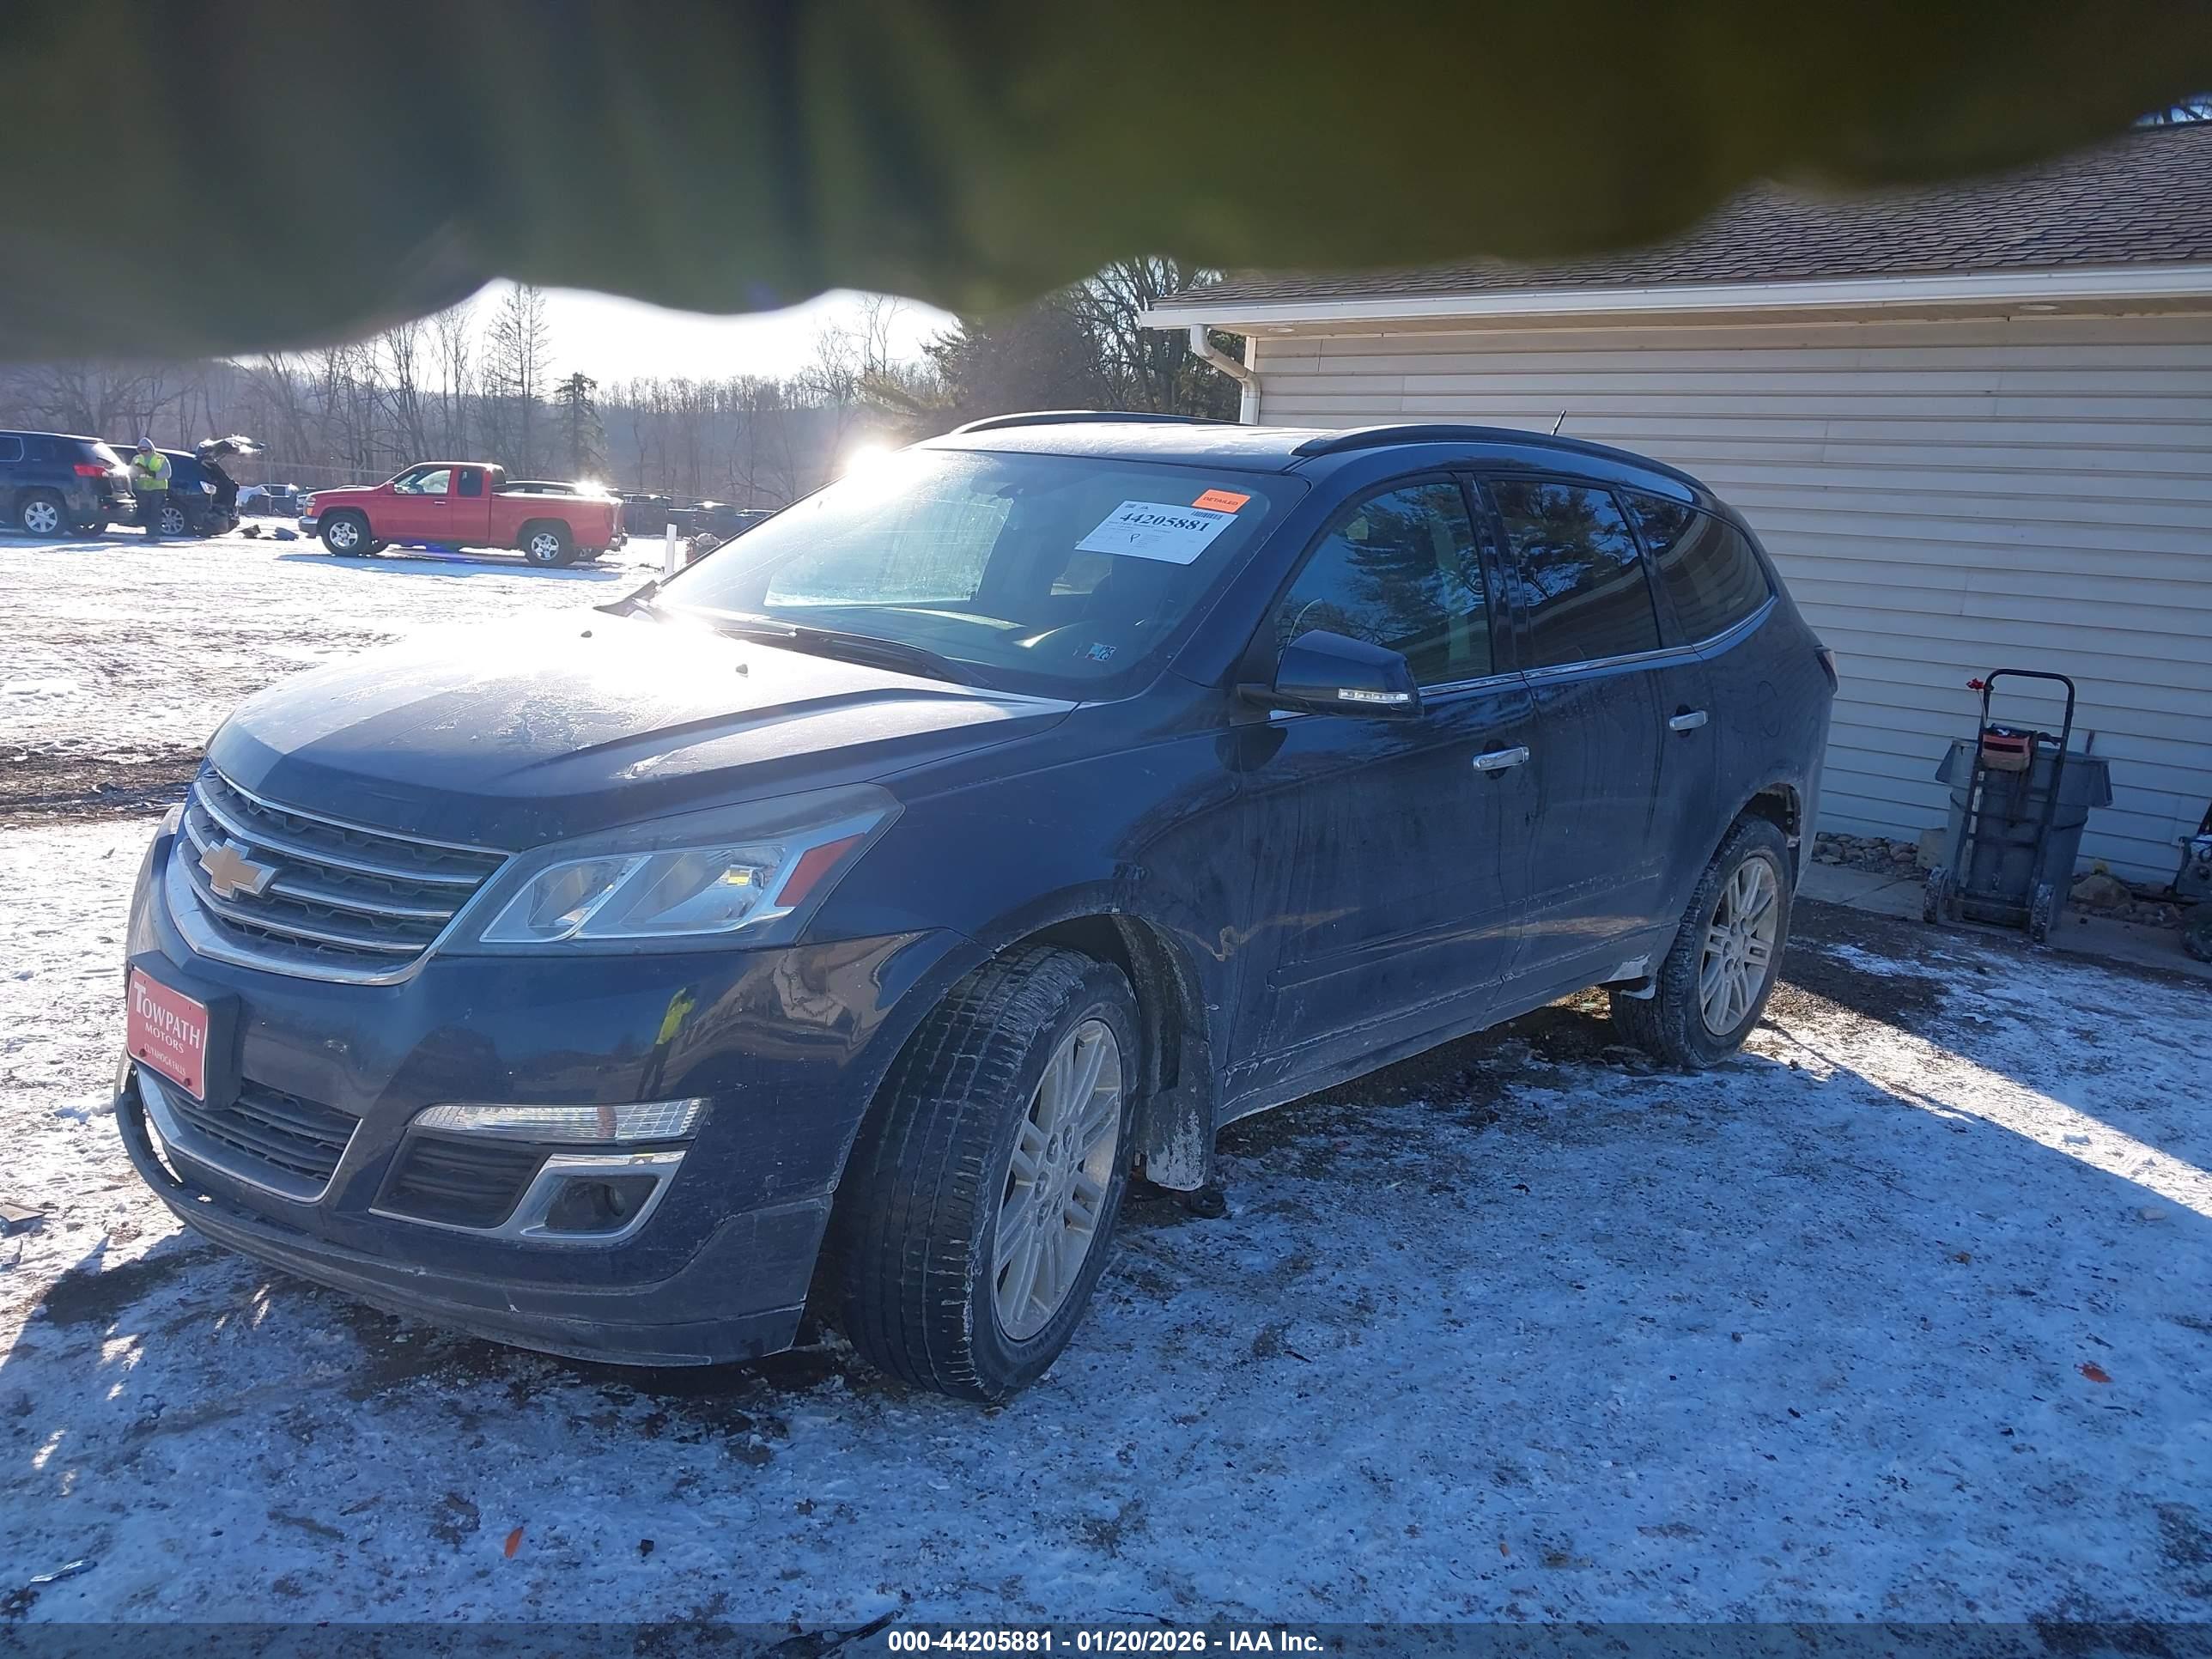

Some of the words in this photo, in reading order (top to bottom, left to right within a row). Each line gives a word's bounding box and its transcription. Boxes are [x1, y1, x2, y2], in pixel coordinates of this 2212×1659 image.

[1203, 496, 1238, 506] DETAILED
[1119, 512, 1210, 532] 44205881
[144, 1022, 184, 1054] MOTORS
